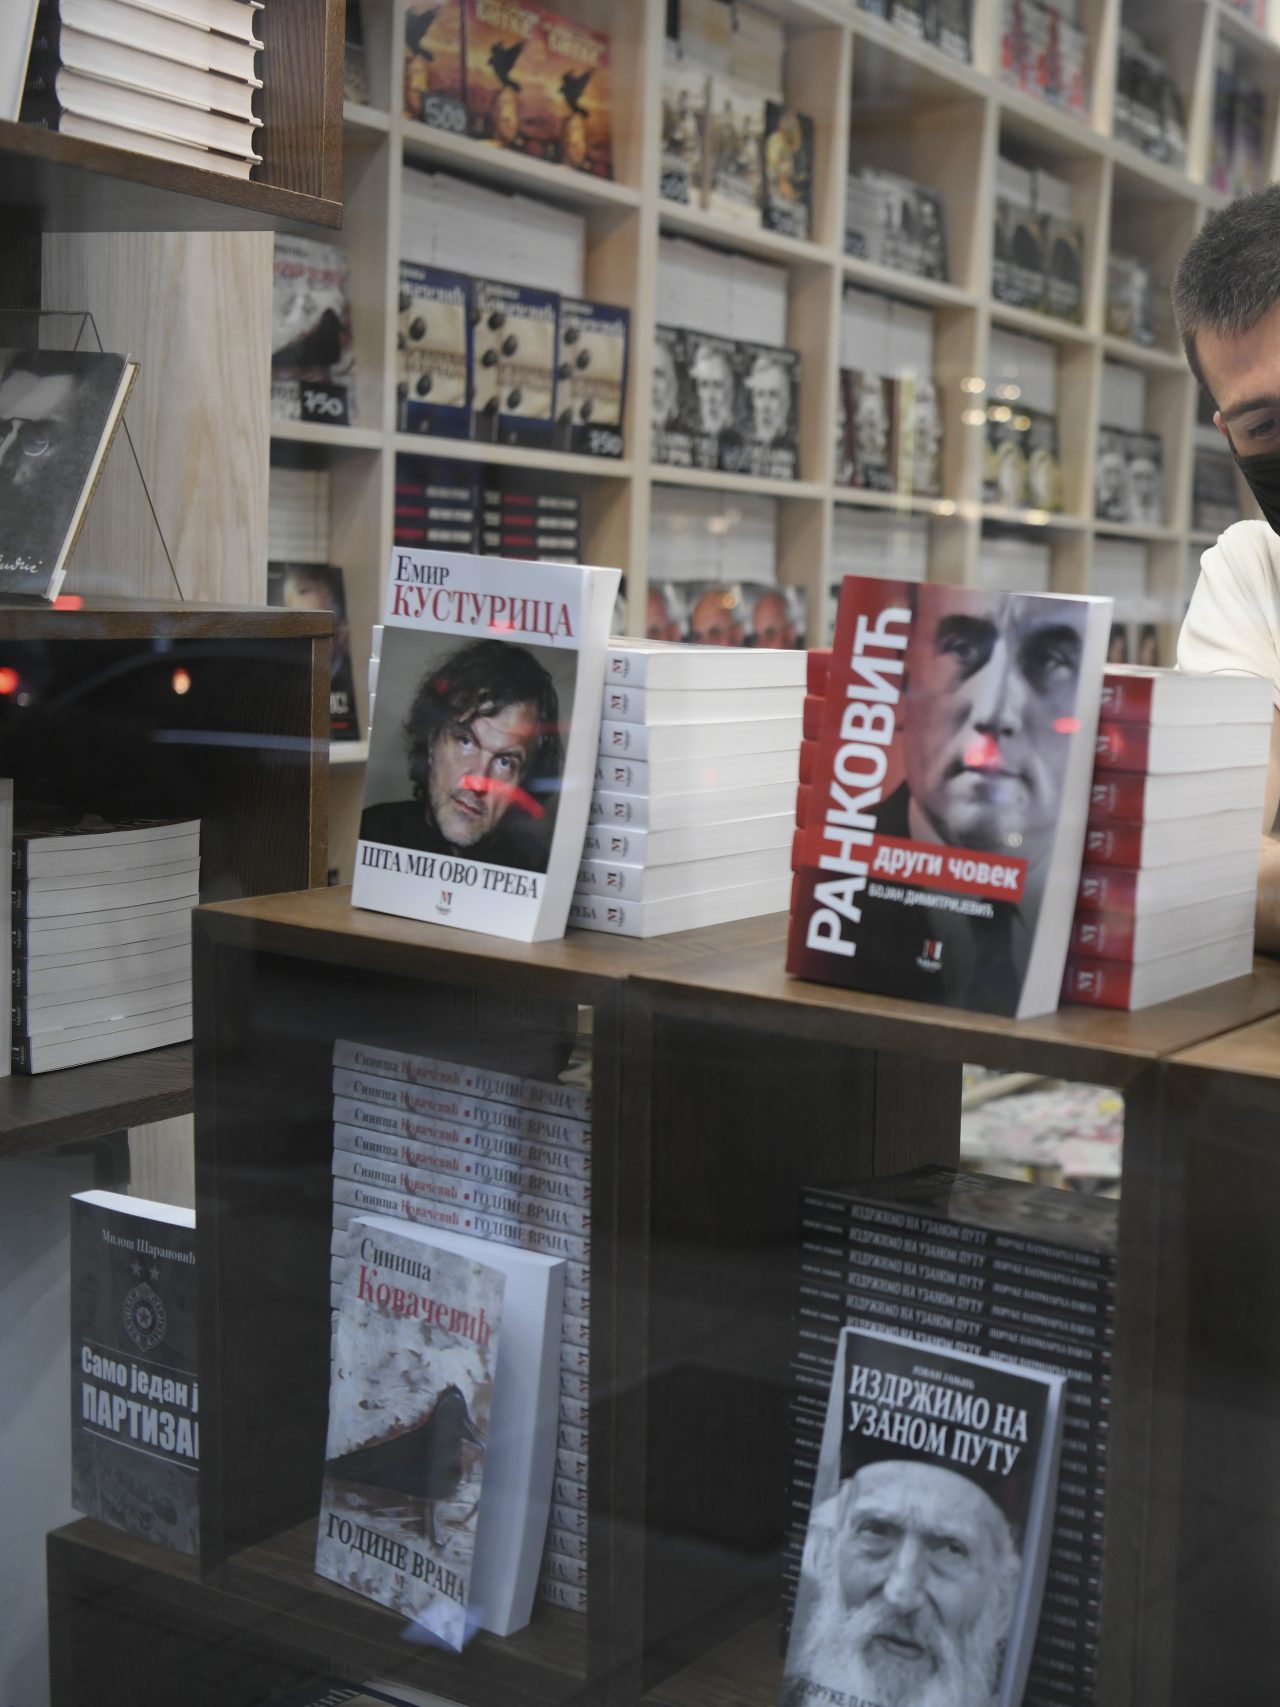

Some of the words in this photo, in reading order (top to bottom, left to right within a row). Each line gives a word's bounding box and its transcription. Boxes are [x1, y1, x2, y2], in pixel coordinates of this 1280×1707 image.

[391, 584, 575, 641] КУСТУРИЦА
[806, 607, 912, 957] РАНКОВИЋ
[361, 845, 401, 872] ШТА
[405, 854, 436, 879] МИ
[439, 860, 478, 887] ОВО
[482, 868, 538, 899] ТРЕБА
[873, 846, 943, 878] други
[948, 858, 1019, 890] човек
[360, 1237, 432, 1282] Синиша
[356, 1264, 492, 1348] Ковачевић
[82, 1345, 127, 1388] Само
[130, 1364, 188, 1408] један
[191, 1382, 199, 1414] ј
[848, 1364, 990, 1431] ИЗДРЖИМО
[992, 1402, 1029, 1443] НА
[848, 1400, 949, 1456] УЗАНОМ
[951, 1428, 1021, 1476] ПУТУ
[326, 1513, 409, 1572] ГОДИНЕ
[411, 1551, 467, 1608] ВРАНА
